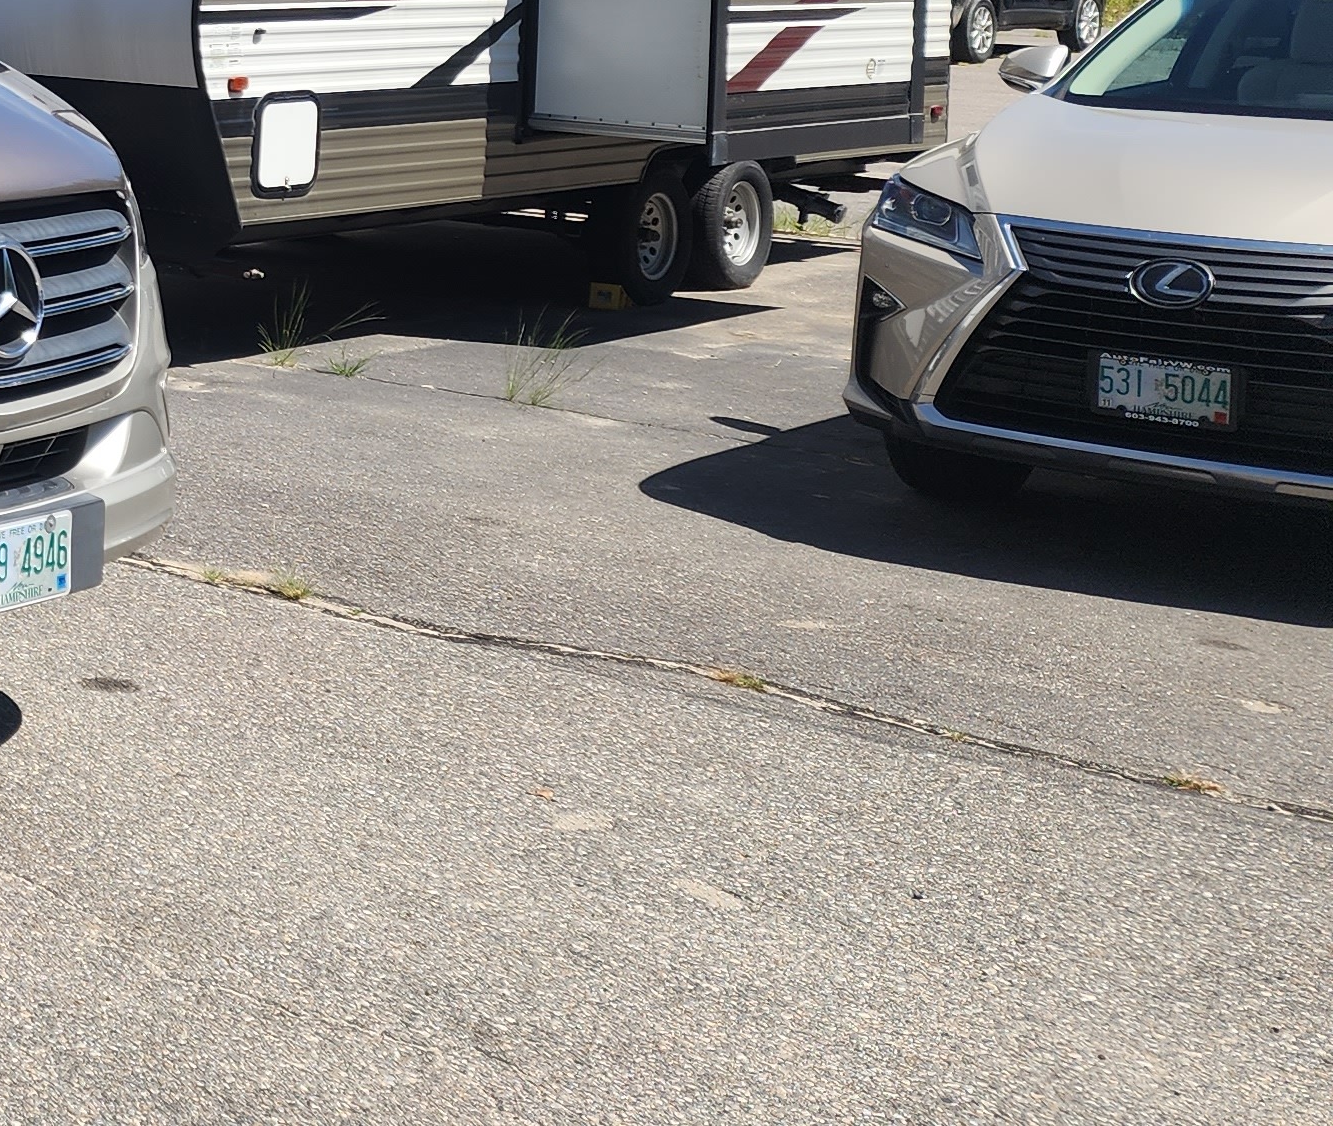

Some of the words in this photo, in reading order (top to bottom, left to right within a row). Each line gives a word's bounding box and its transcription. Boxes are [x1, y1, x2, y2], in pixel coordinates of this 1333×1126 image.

[1100, 352, 1231, 374] AutoFairVW.com
[1099, 365, 1142, 398] 531
[1164, 372, 1228, 410] 5044
[1125, 412, 1199, 427] 603-943-8700
[21, 530, 68, 577] 4946
